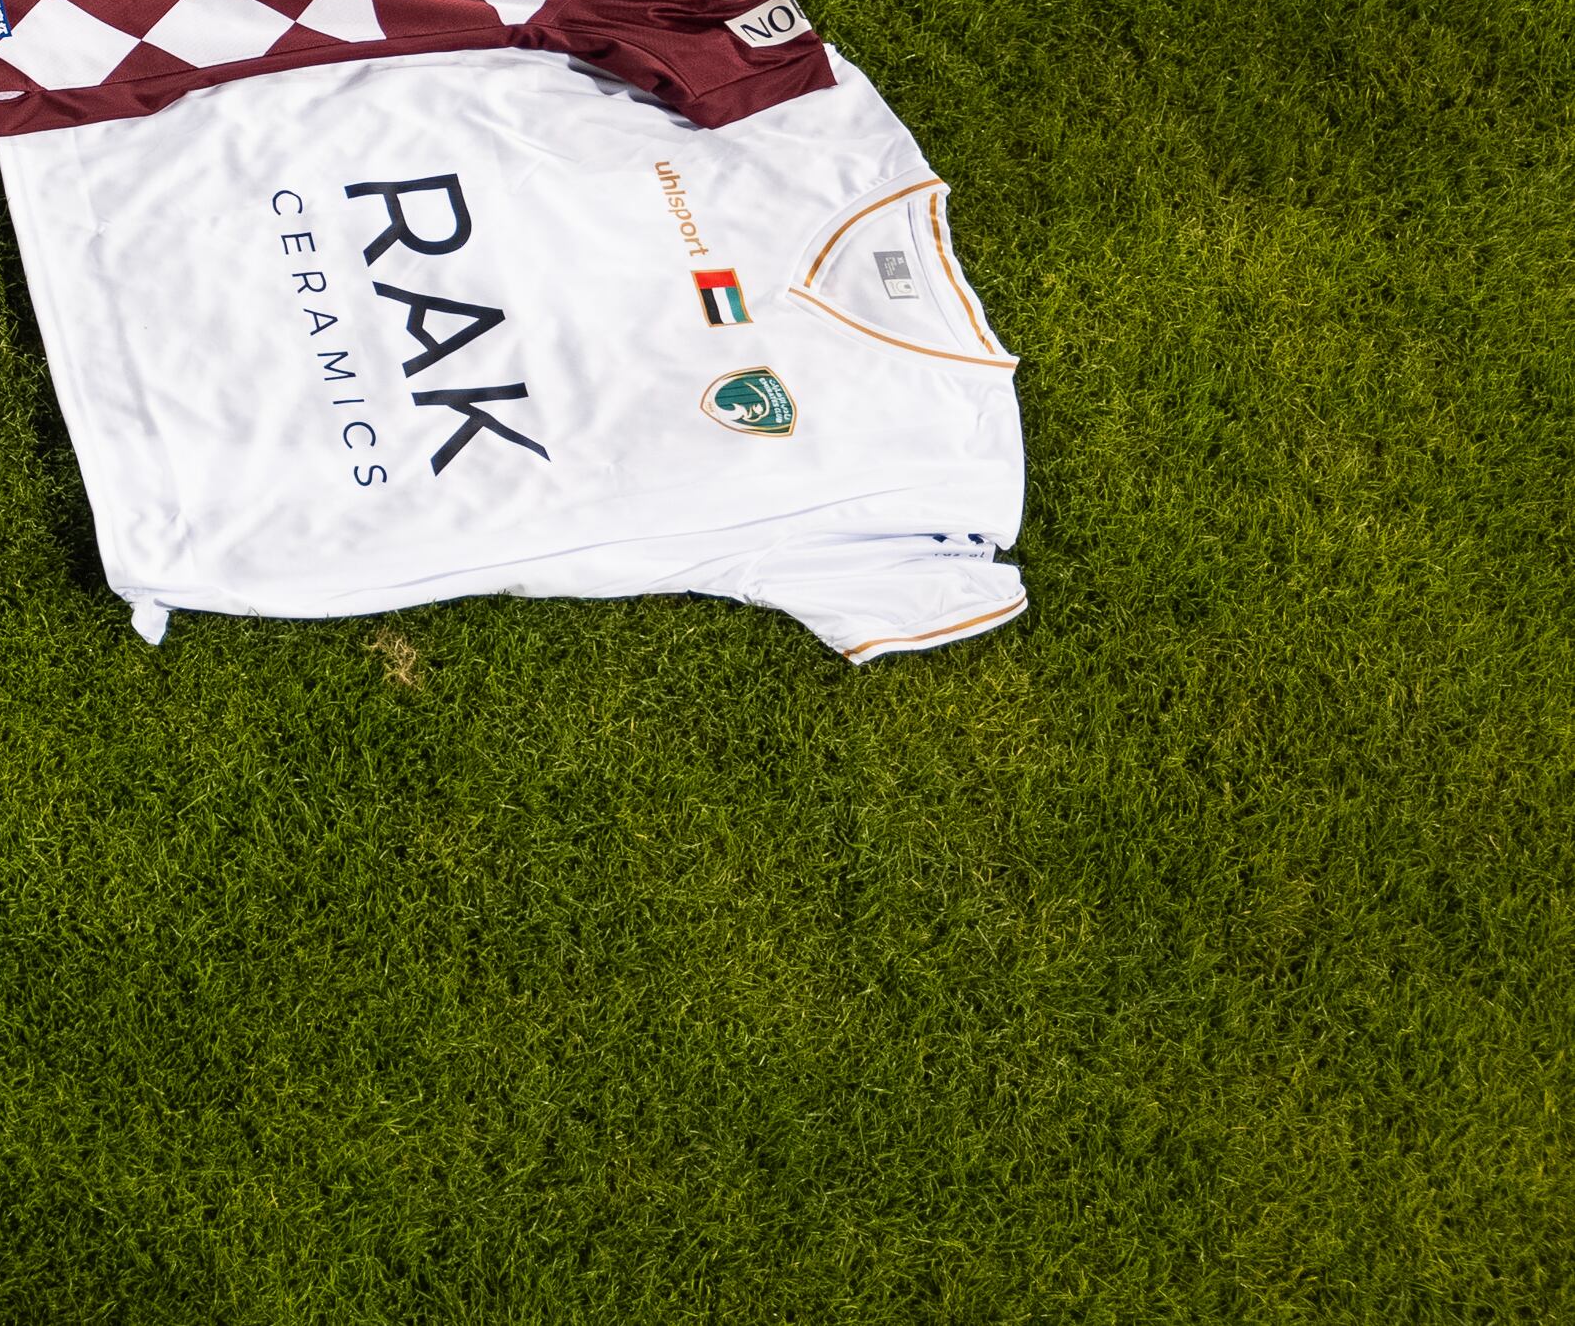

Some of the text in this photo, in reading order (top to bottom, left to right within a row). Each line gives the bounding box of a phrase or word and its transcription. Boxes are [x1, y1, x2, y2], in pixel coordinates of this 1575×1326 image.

[655, 161, 708, 257] uhlsport
[272, 190, 388, 487] CERAMICS
[345, 173, 550, 477] RAK
[759, 377, 783, 424] EMIRATES CLUB
